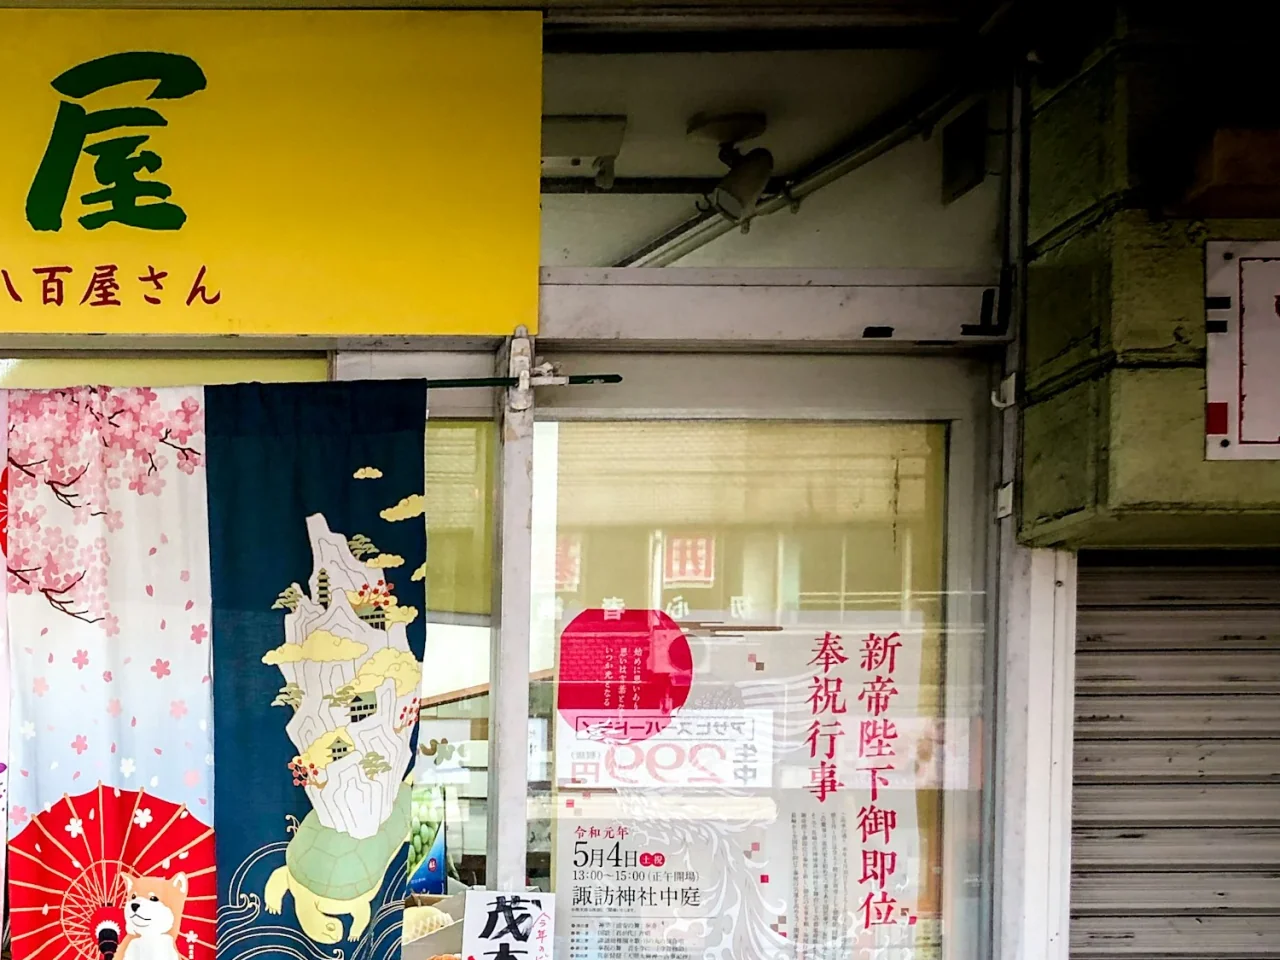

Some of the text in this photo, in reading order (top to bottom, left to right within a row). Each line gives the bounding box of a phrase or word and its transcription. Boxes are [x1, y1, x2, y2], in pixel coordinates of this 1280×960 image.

[804, 631, 849, 802] 奉祝行事
[857, 631, 902, 930] 新帝陛下御即位
[574, 825, 630, 840] 令和元年
[573, 841, 637, 868] 5月4日
[572, 886, 701, 907] 諏訪神社中庭
